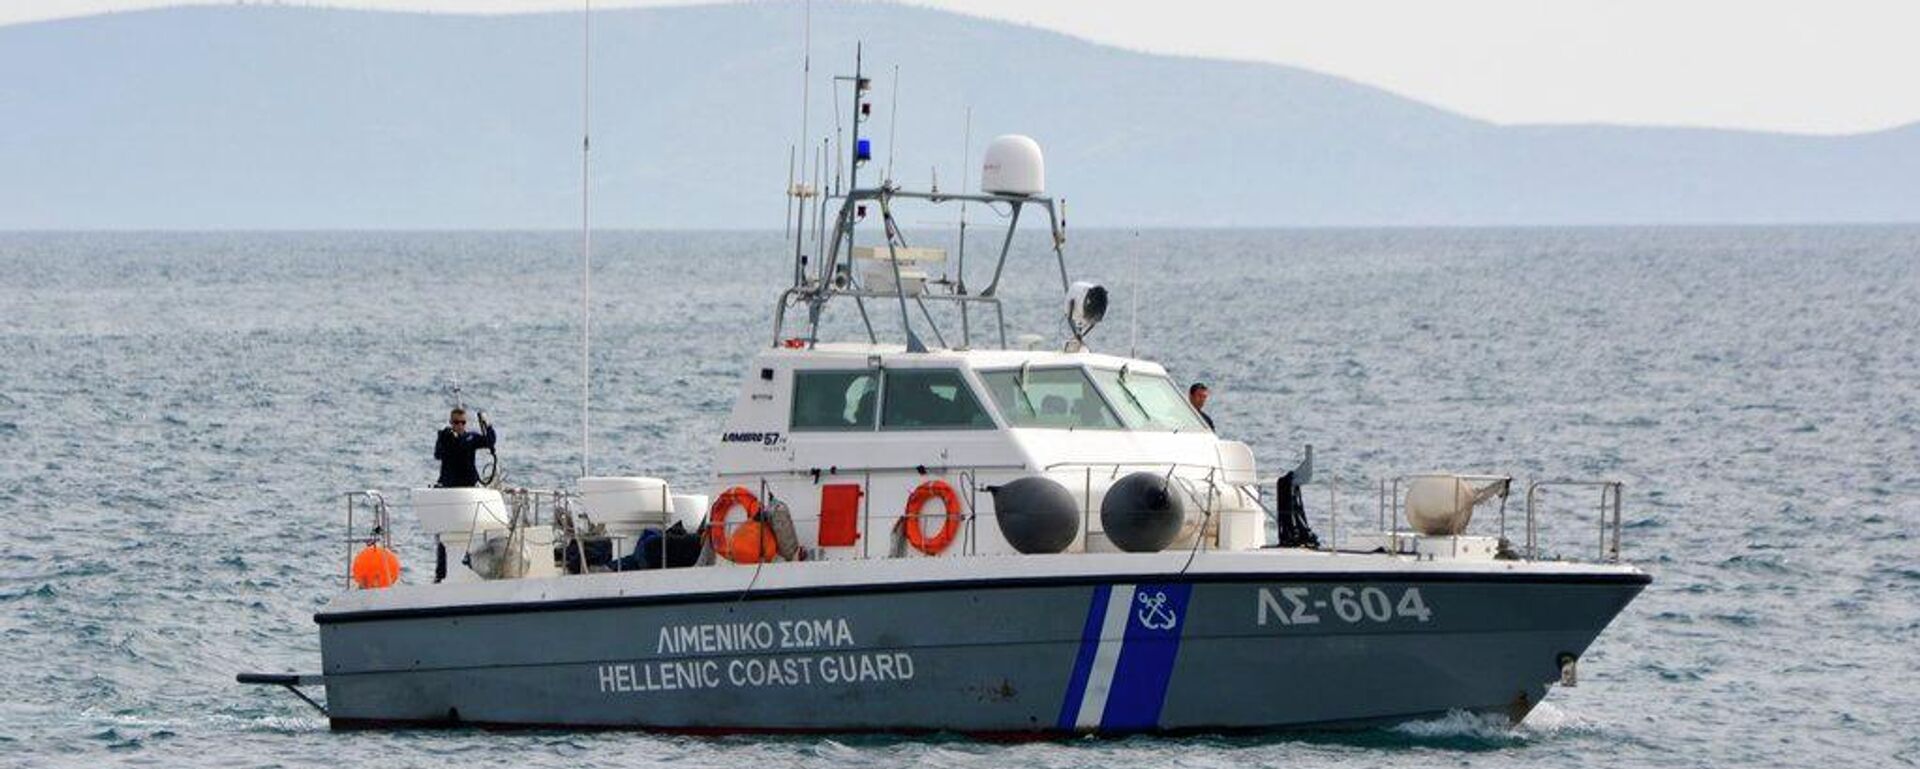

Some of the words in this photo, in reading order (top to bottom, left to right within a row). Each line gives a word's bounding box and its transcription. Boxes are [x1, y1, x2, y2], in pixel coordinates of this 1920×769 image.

[764, 432, 780, 446] 57
[657, 621, 774, 654] ΛΙΜΕΝΙΚΟ
[780, 618, 854, 649] ΣΩΜΑ
[599, 660, 720, 693] HELLENIC
[728, 658, 812, 687] COAST
[819, 653, 915, 684] GUARD
